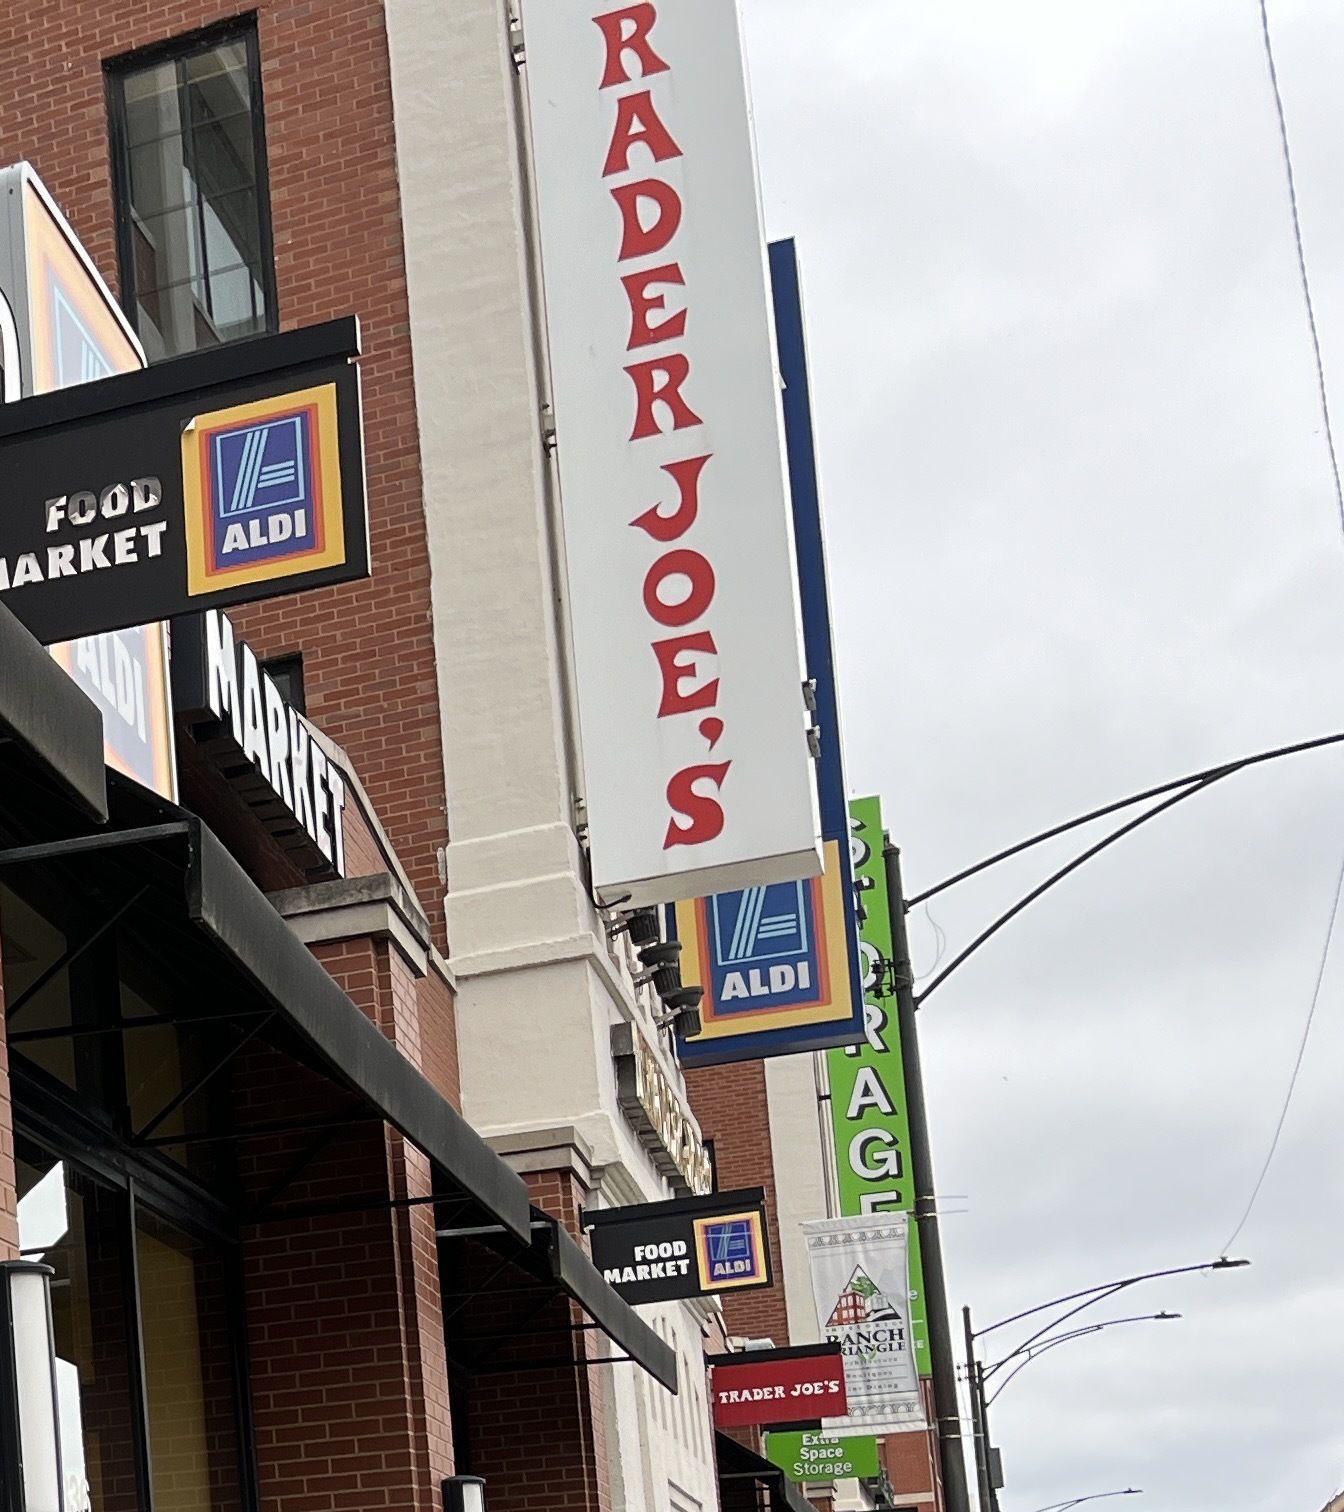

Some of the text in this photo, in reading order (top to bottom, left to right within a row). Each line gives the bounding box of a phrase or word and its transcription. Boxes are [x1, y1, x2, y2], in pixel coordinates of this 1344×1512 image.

[45, 476, 162, 532] FOOD
[222, 508, 308, 554] ALDI
[628, 453, 733, 851] JOE'S
[76, 624, 147, 744] ALDI
[205, 608, 346, 879] MARKET
[720, 961, 812, 1001] ALDI
[634, 1240, 687, 1262] FOOD
[603, 1259, 690, 1285] MARKET
[714, 1259, 752, 1276] ALDI
[841, 1341, 905, 1356] RIANGLE
[719, 1380, 840, 1404] TRADER JOE'S
[799, 1446, 844, 1461] Space
[793, 1461, 853, 1476] Storage
